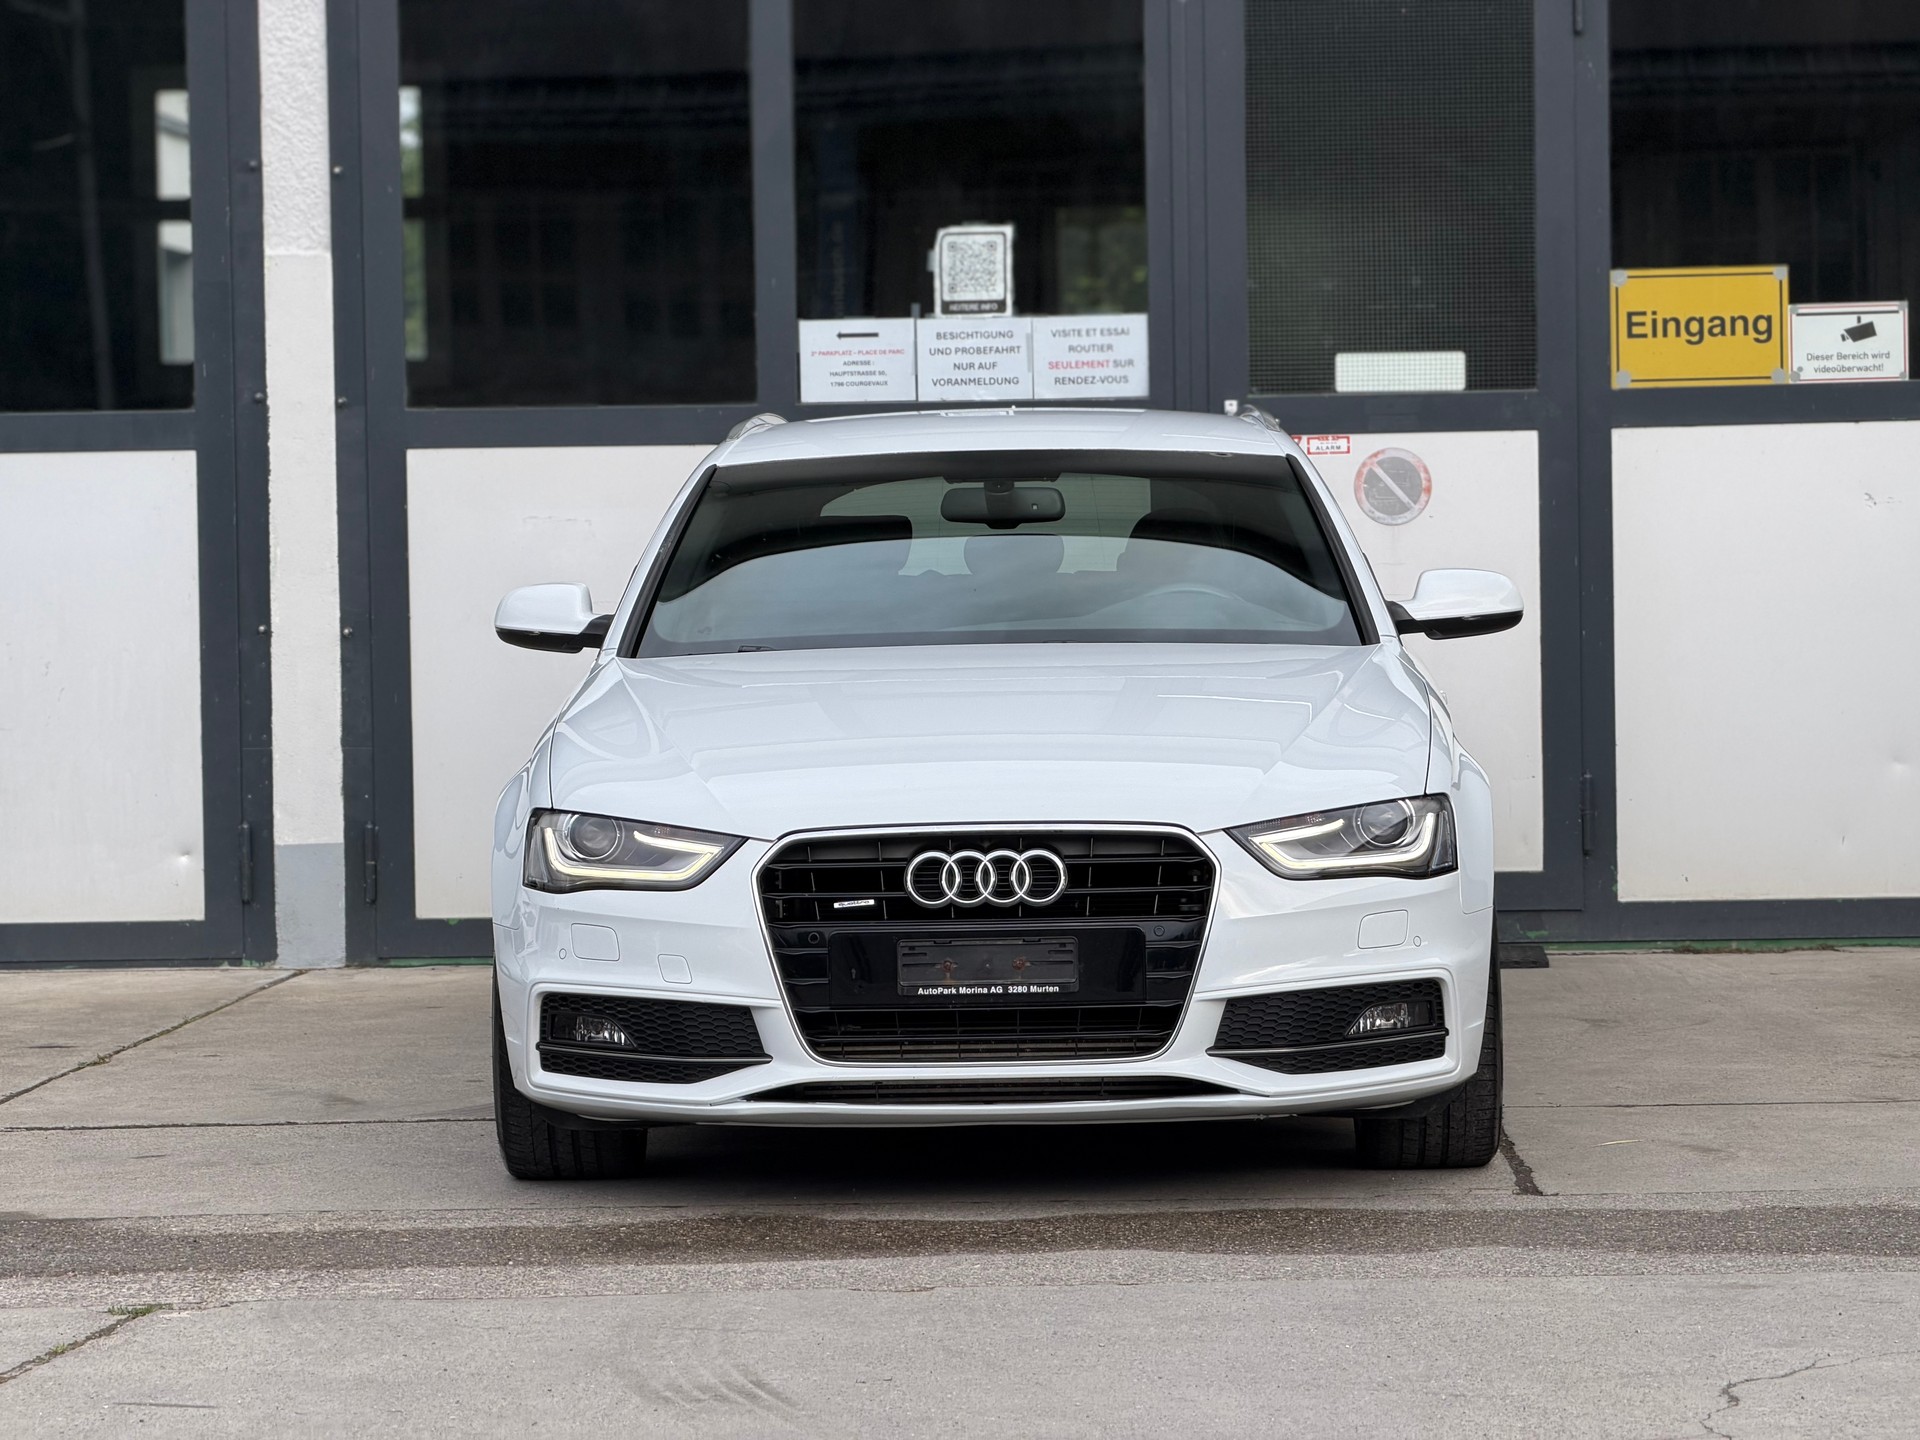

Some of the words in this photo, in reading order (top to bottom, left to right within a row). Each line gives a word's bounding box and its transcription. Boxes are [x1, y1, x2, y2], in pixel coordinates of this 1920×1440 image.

[1051, 328, 1083, 338] VISITE
[1085, 328, 1097, 337] ET
[1100, 327, 1130, 336] ESSAI
[1626, 310, 1773, 345] Eingang
[936, 330, 1014, 340] BESICHTIGUNG
[929, 347, 952, 356] UND
[954, 345, 1021, 355] PROBEFAHRT
[1068, 343, 1113, 353] ROUTIER
[1806, 352, 1833, 362] Dieser
[1836, 351, 1869, 361] Bereich
[1871, 351, 1890, 360] wird
[953, 362, 976, 371] NUR
[977, 361, 998, 370] AUF
[1048, 360, 1109, 370] SEULEMENT
[1112, 359, 1135, 368] SUR
[1813, 363, 1884, 374] videoüberwacht!
[931, 376, 1020, 387] VORANMELDUNG
[1054, 375, 1128, 386] RENDEZ-VOUS
[917, 986, 957, 995] AutoPark
[959, 985, 988, 994] Morina
[990, 985, 1003, 994] AG
[1007, 985, 1028, 993] 3280
[1030, 984, 1059, 993] Murten
